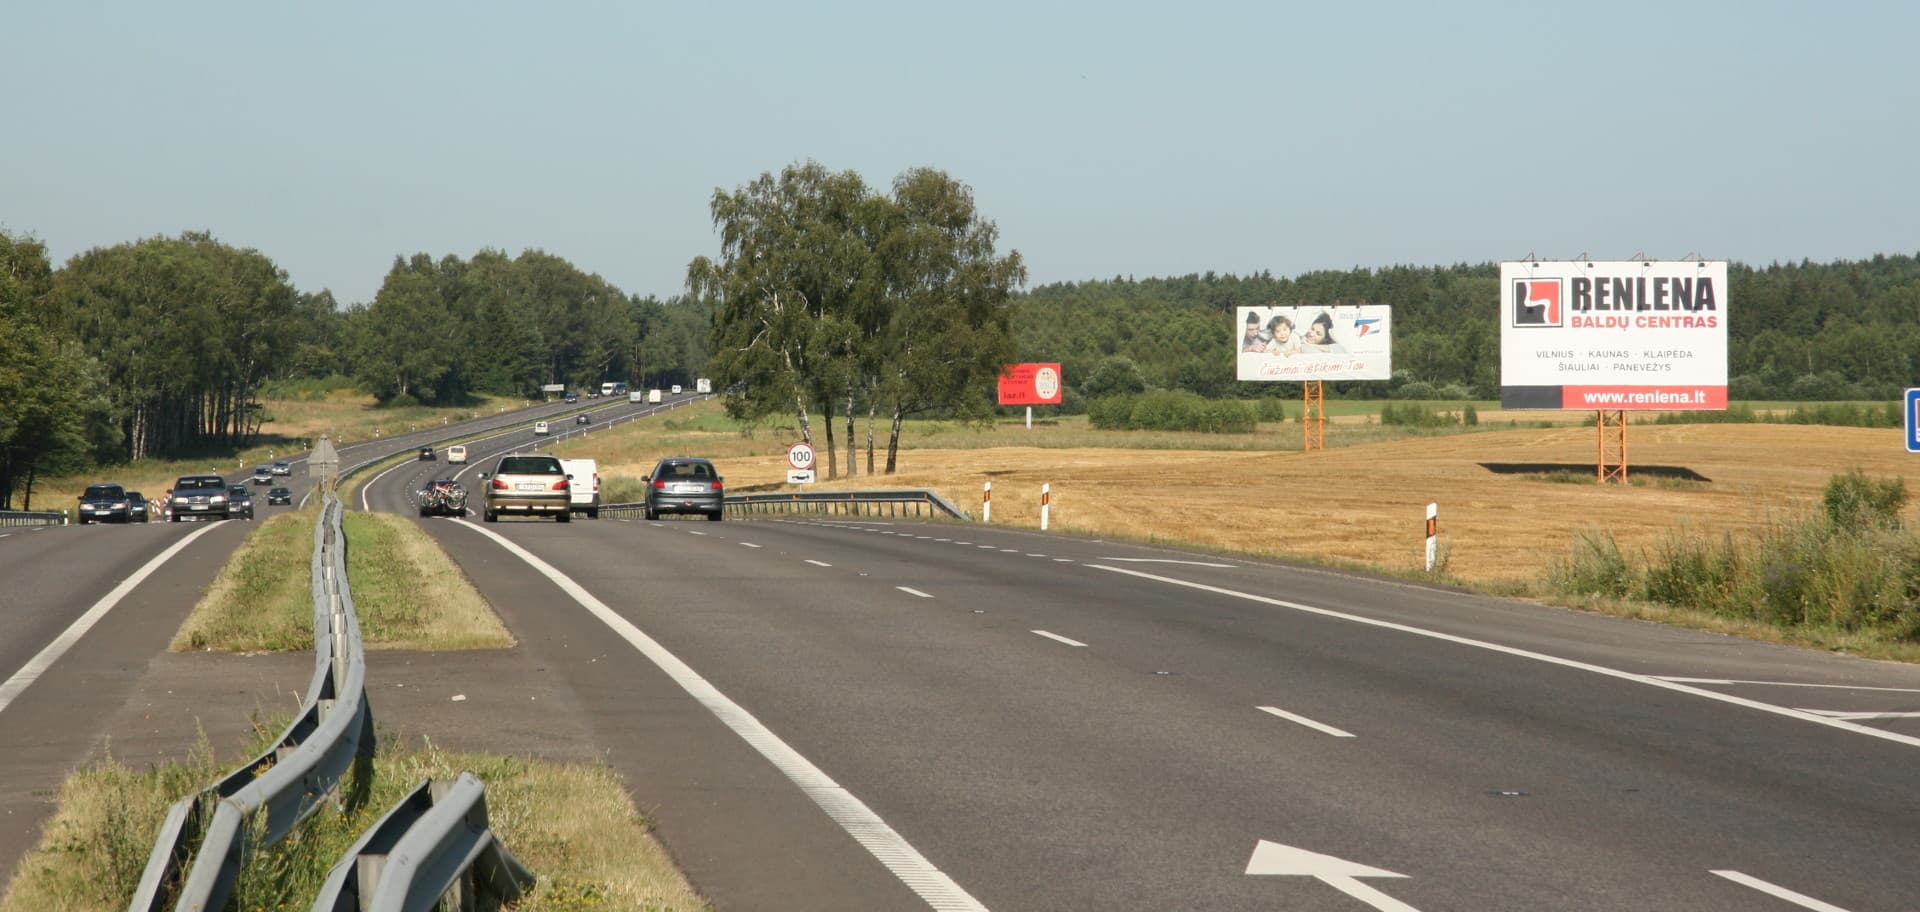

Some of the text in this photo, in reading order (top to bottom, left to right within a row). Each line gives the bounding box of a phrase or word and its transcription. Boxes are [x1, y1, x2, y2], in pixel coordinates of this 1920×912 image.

[1571, 277, 1717, 311] RENLENA
[1571, 315, 1718, 331] BALDŲ CENTRAS
[1536, 350, 1574, 359] VILNIUS
[1588, 350, 1630, 359] KAUNAS
[1558, 361, 1600, 372] ŠIAULIAI
[1583, 389, 1706, 404] www.renlena.lt
[792, 451, 811, 462] 100
